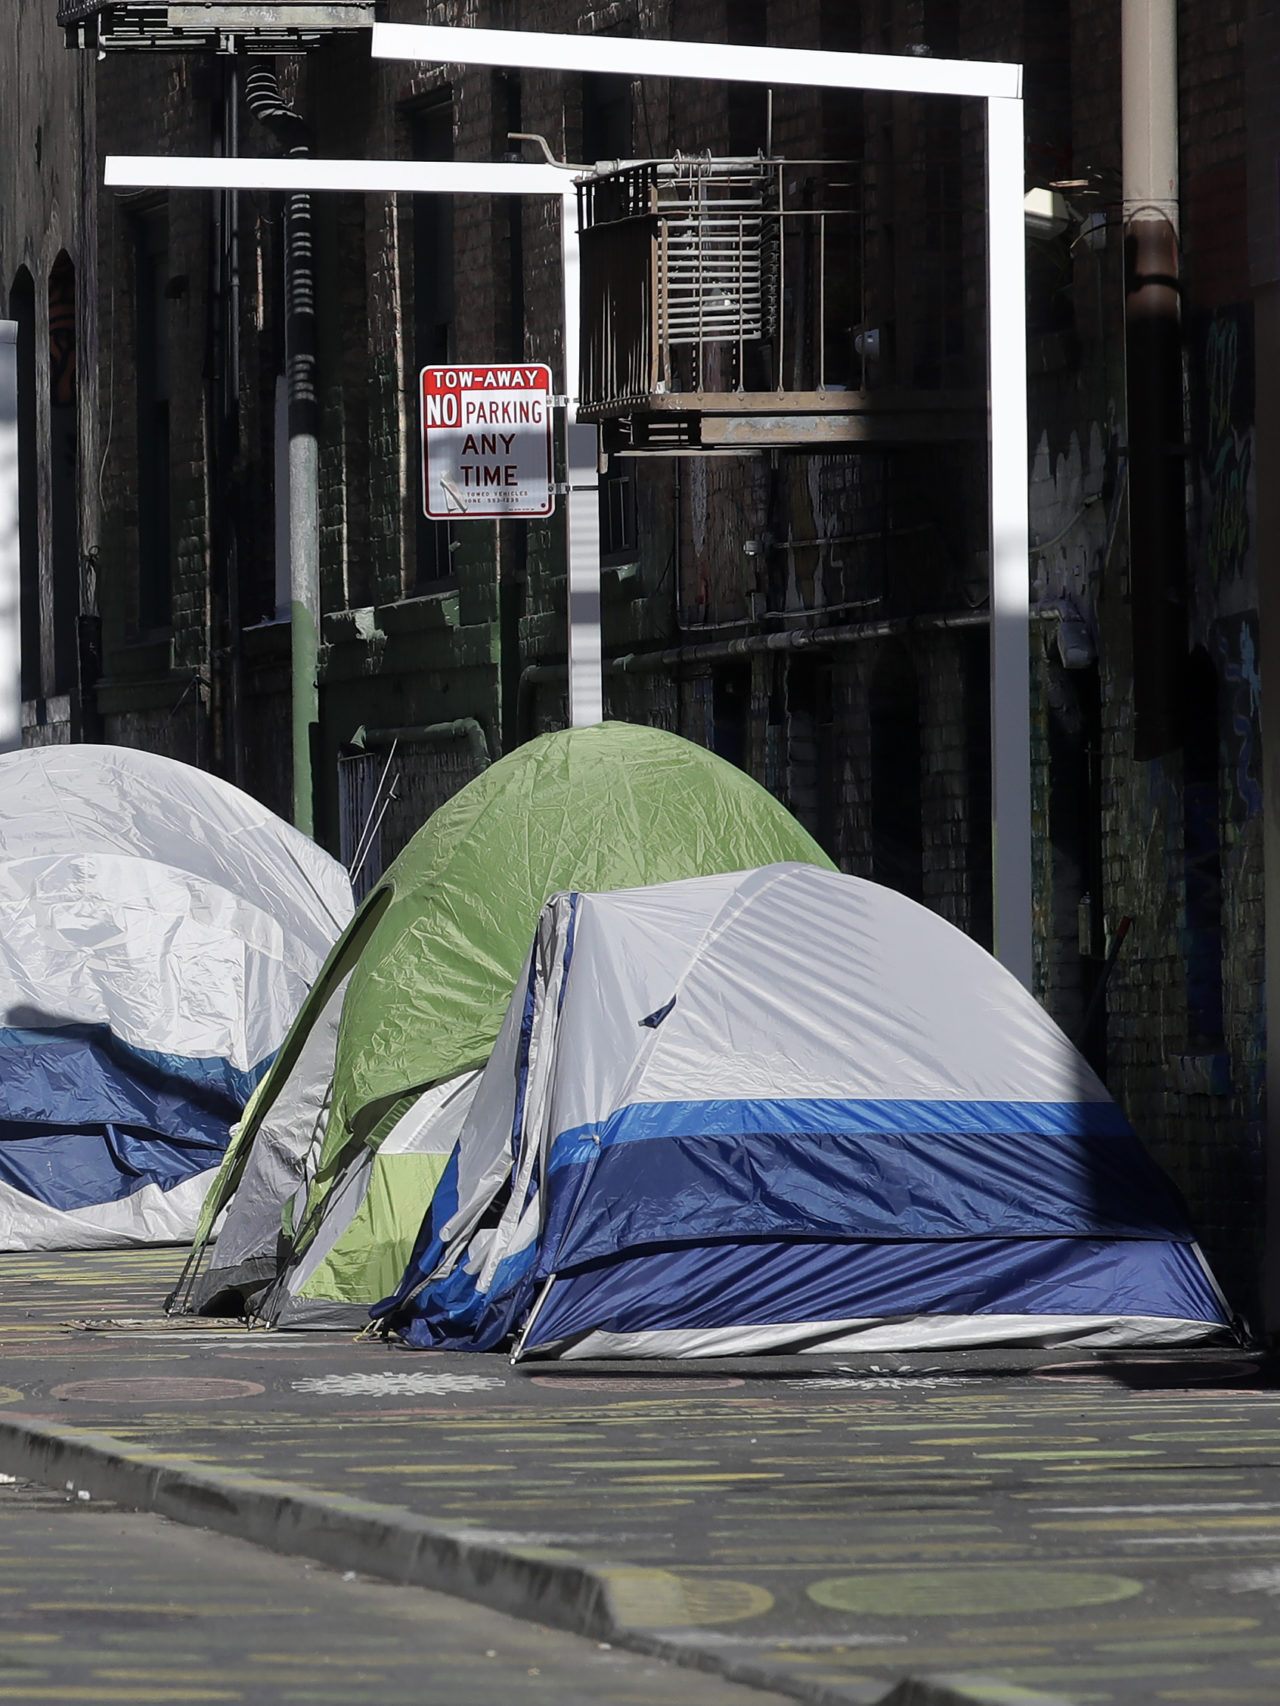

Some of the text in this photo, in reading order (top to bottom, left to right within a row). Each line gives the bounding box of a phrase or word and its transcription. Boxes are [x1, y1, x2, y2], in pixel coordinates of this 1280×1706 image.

[432, 369, 538, 388] TOW-AWAY
[426, 393, 542, 426] NO PARKING
[461, 433, 516, 455] ANY
[460, 465, 518, 487] TIME
